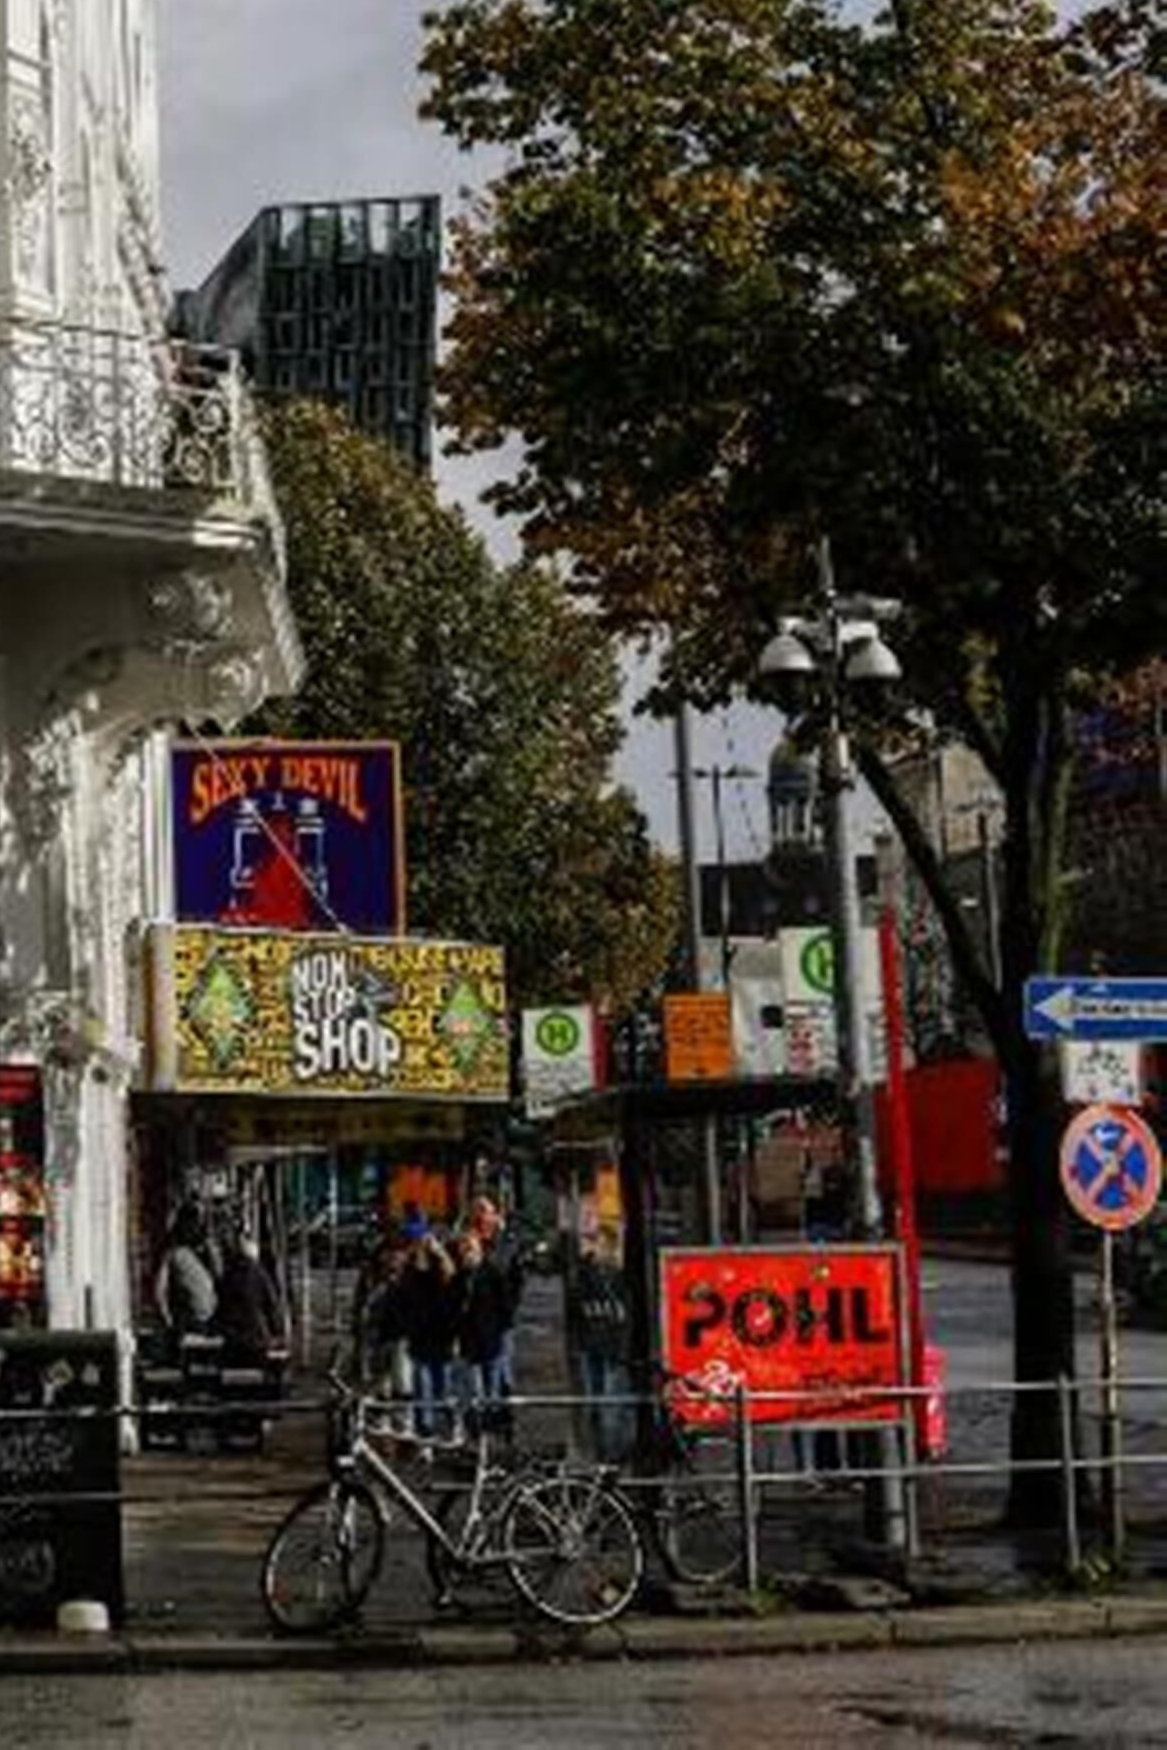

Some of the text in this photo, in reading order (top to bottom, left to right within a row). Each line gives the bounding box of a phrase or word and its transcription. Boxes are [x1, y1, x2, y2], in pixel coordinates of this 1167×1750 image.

[190, 757, 368, 825] SEXY DEVIL
[293, 951, 350, 990] NON
[294, 986, 357, 1021] STOP
[294, 1018, 401, 1079] SHOP
[684, 1286, 890, 1346] POHL
